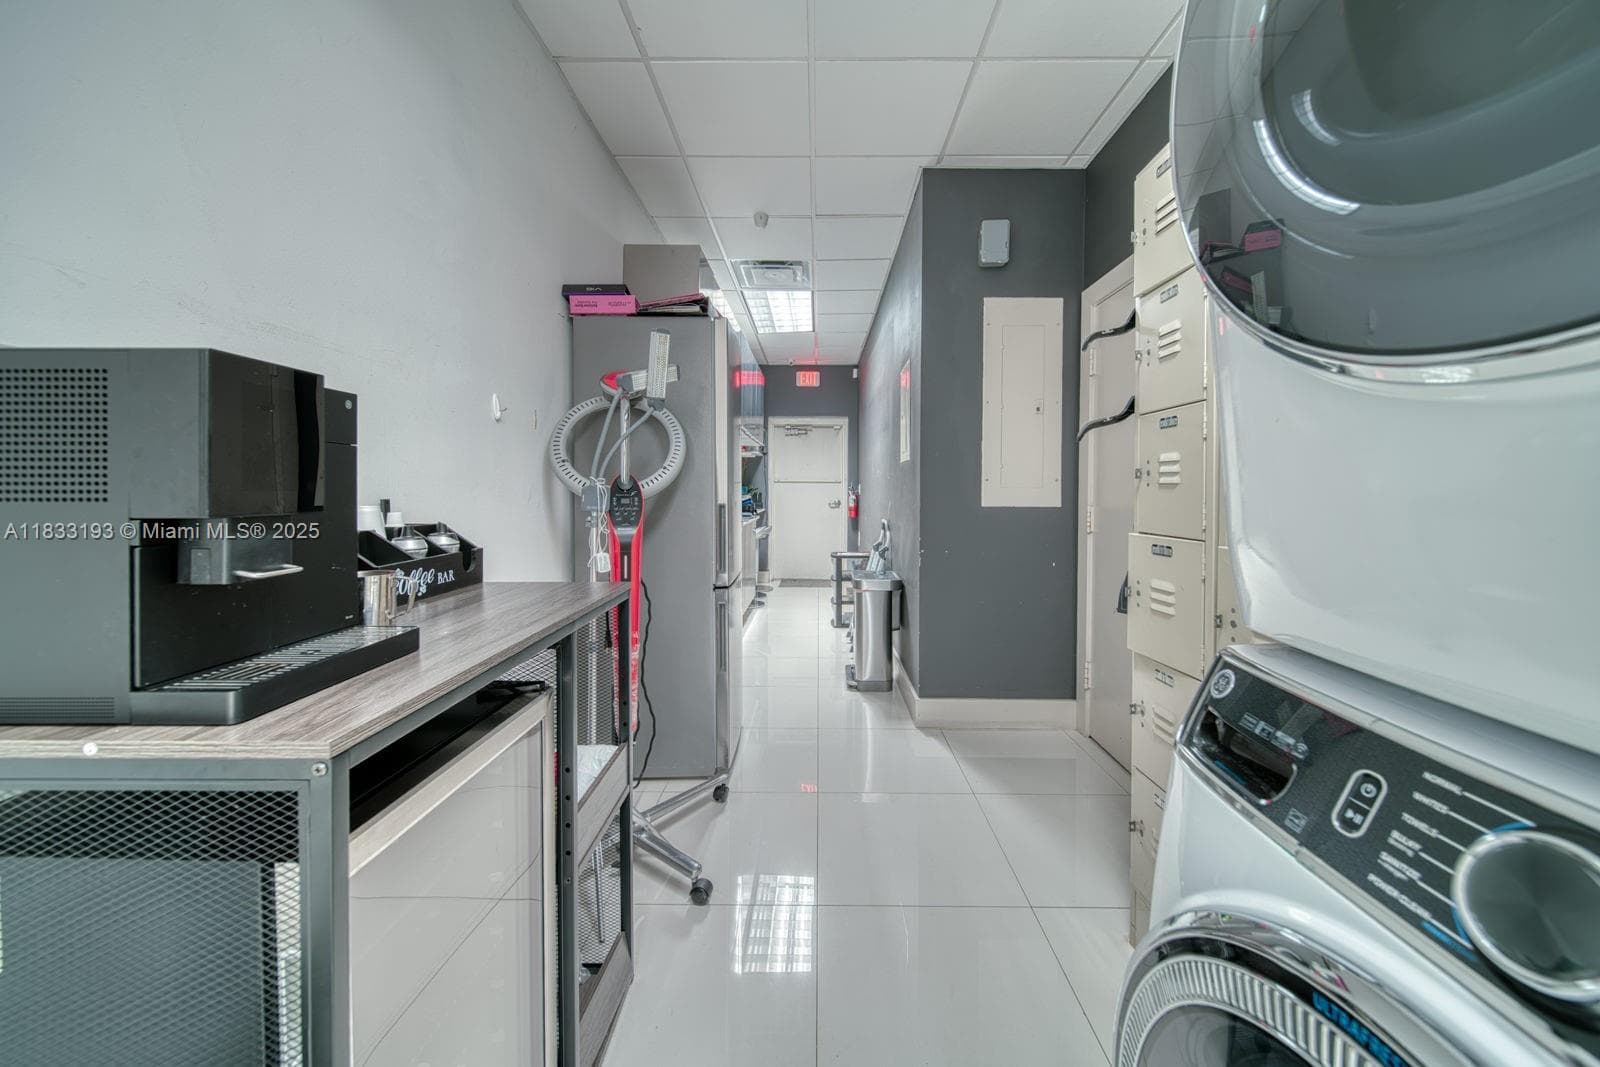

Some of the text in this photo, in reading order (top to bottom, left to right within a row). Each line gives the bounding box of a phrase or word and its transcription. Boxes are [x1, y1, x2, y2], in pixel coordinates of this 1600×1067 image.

[799, 371, 817, 385] EXIT
[437, 570, 455, 584] BAR
[1401, 812, 1440, 838] TOWELS
